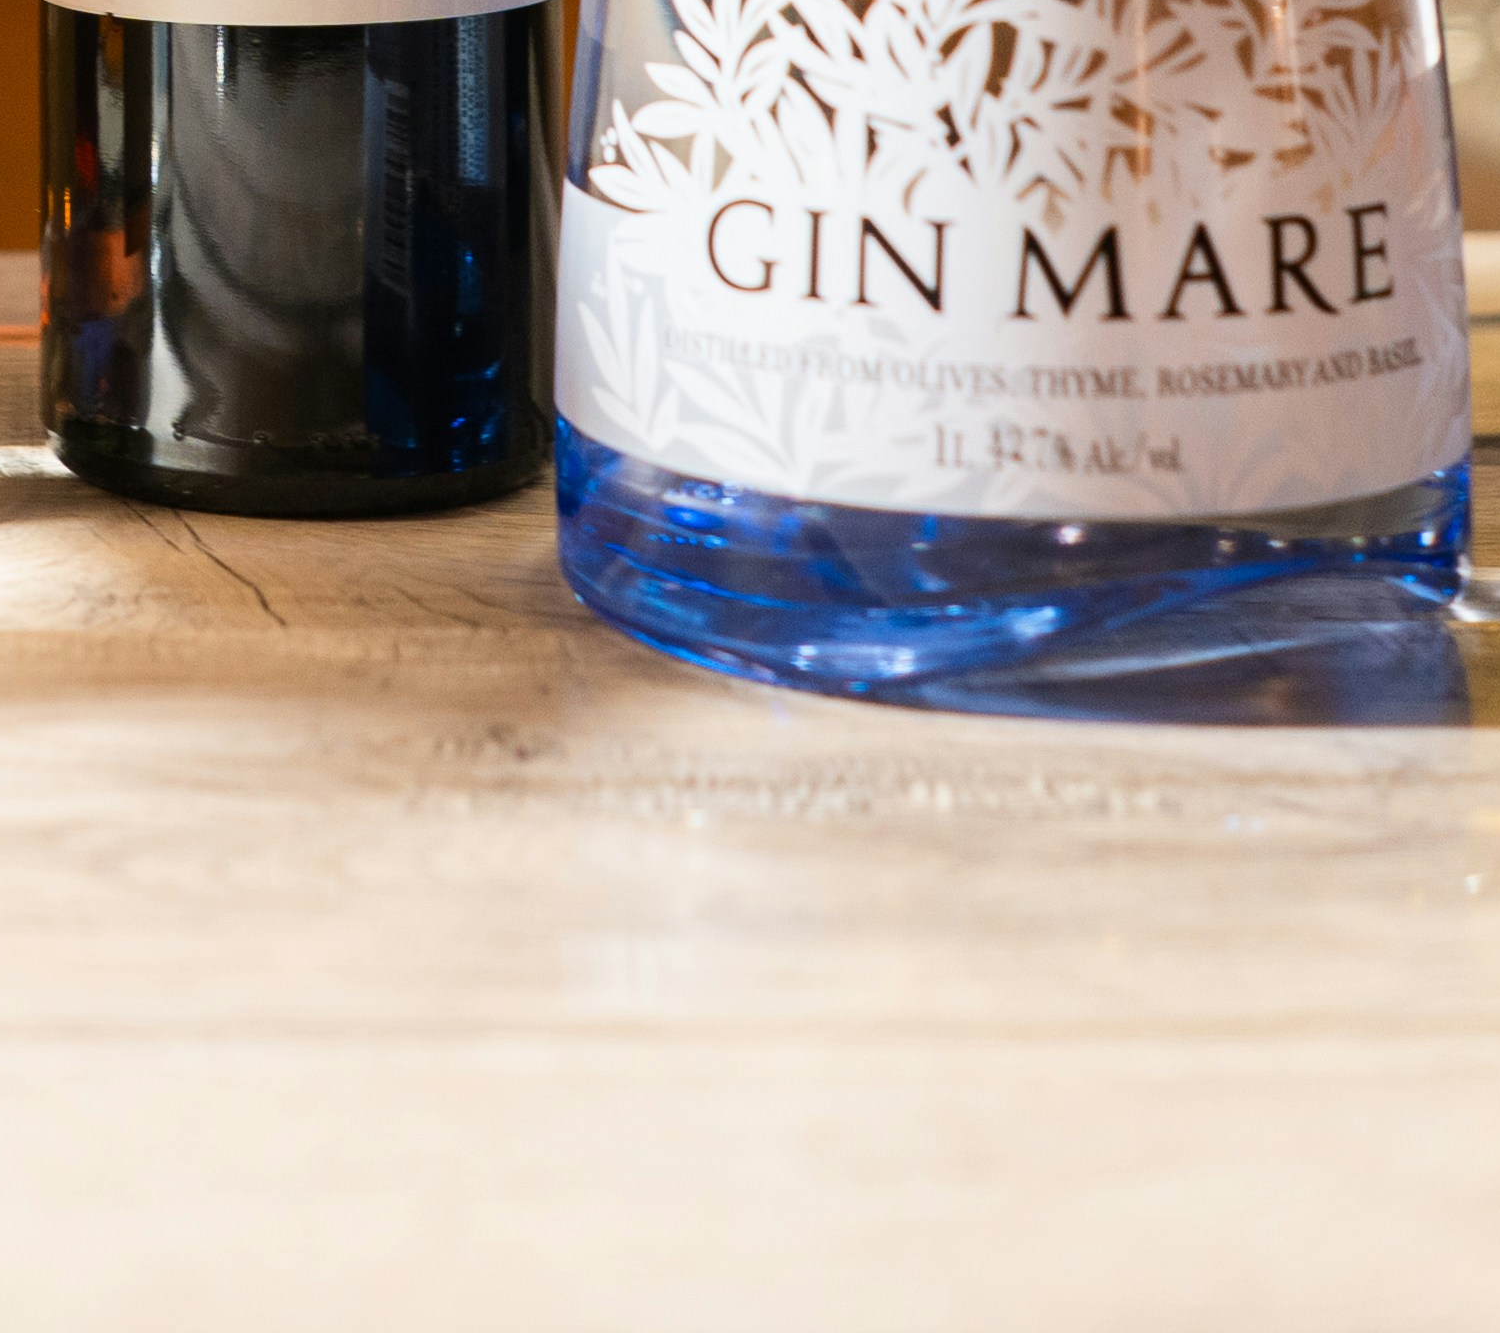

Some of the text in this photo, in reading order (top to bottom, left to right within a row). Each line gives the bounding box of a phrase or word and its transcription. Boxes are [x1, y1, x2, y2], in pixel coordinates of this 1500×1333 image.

[706, 198, 1396, 325] GIN MARE
[1155, 358, 1307, 397] ROSEMARY
[1312, 348, 1364, 388] AND
